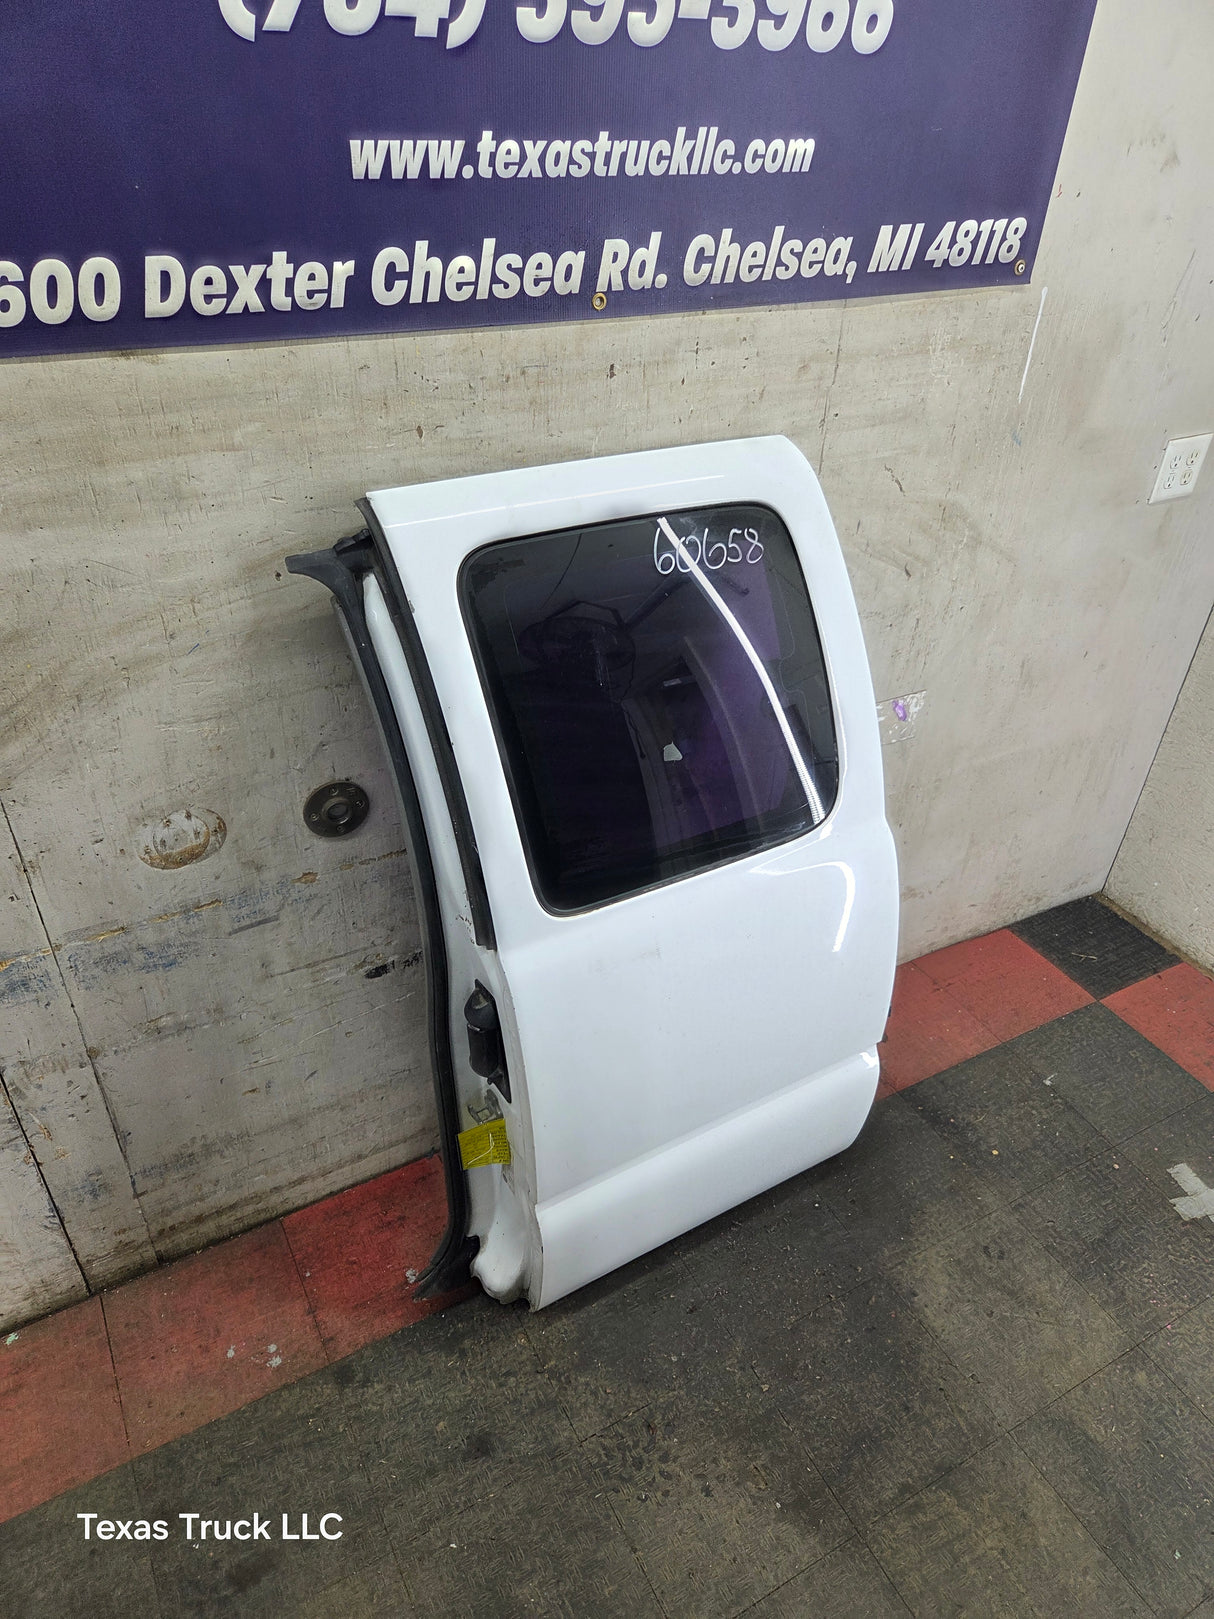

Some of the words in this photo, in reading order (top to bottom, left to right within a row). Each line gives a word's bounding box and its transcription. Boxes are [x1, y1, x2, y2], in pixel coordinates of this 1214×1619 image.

[350, 126, 816, 180] www.texastruckllc.com
[0, 256, 121, 328] 600
[145, 250, 356, 318] Dexter
[371, 237, 586, 306] Chelsea
[596, 231, 668, 293] Rd.
[684, 225, 858, 284] Chelsea,
[867, 222, 926, 273] MI
[925, 216, 1028, 268] 48118
[653, 527, 765, 575] 60658
